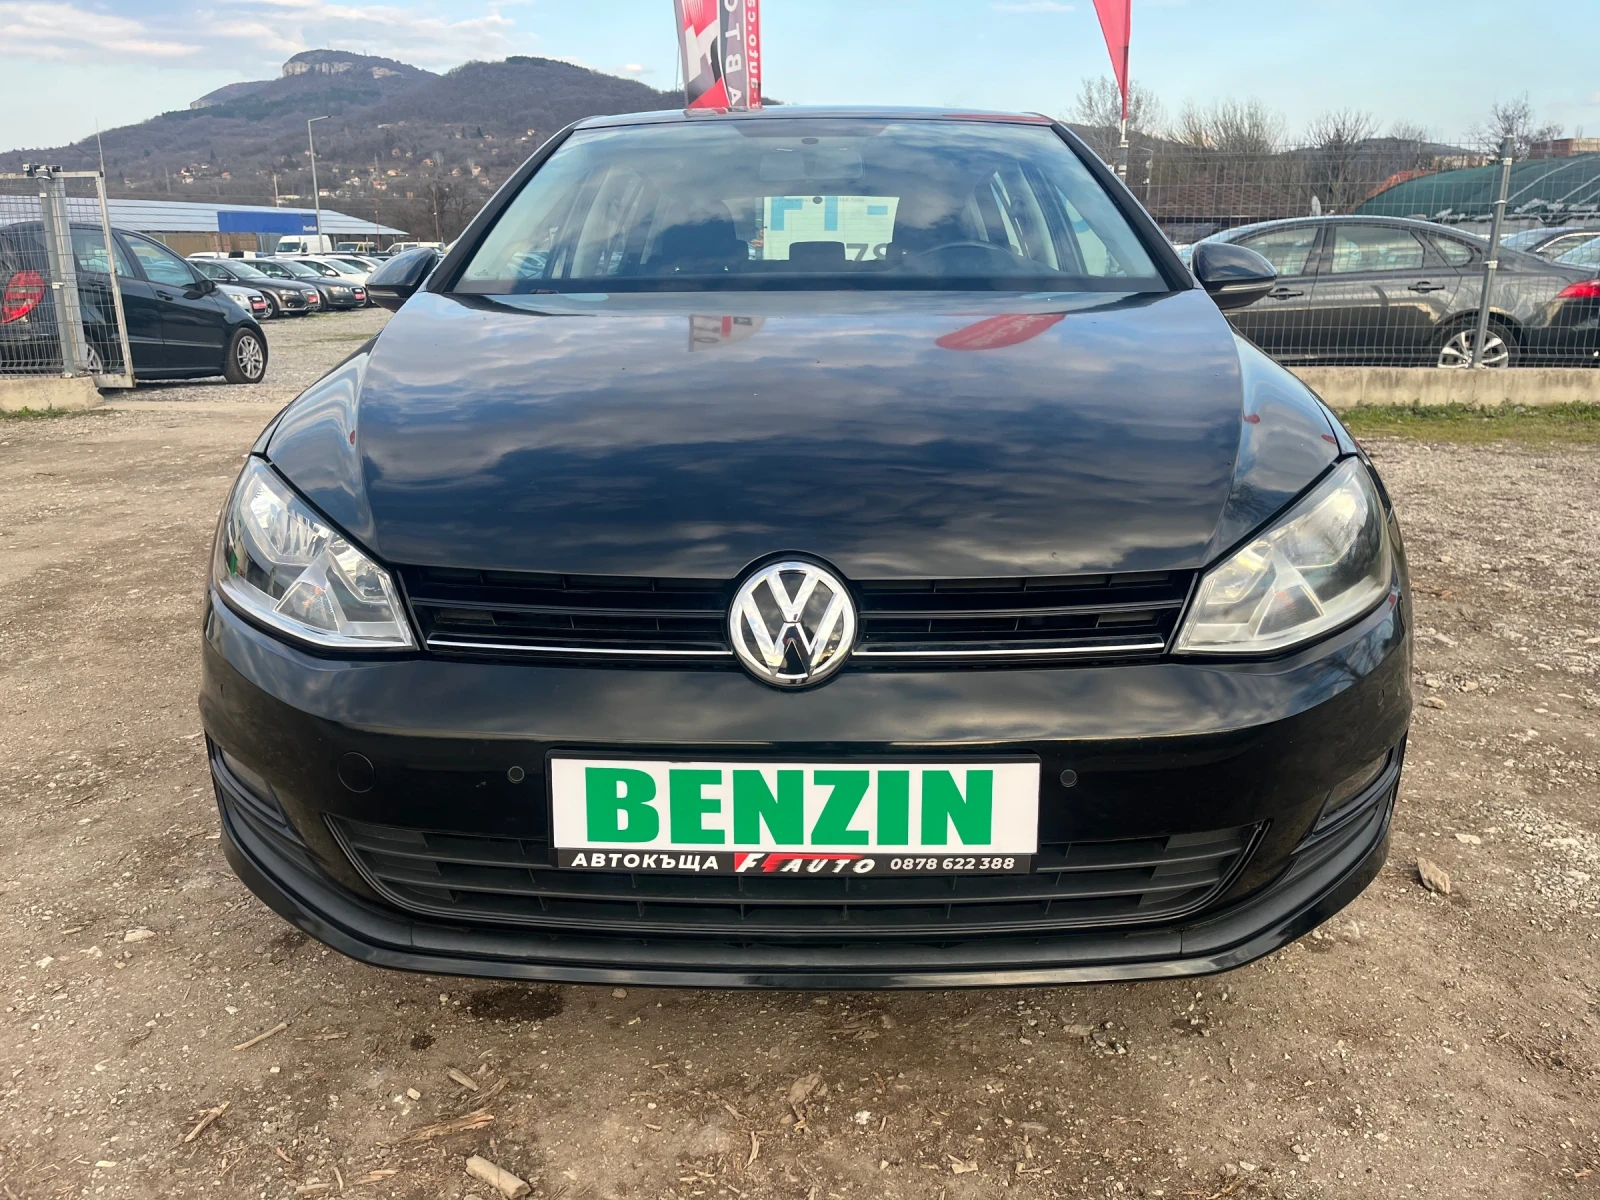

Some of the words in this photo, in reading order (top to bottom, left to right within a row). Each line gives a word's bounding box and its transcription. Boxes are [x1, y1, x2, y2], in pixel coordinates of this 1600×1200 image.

[585, 766, 994, 846] BENZIN
[571, 852, 719, 872] АВТОКЪЩА
[890, 857, 937, 871] 0878
[942, 857, 975, 870] 622
[979, 857, 1015, 870] 388
